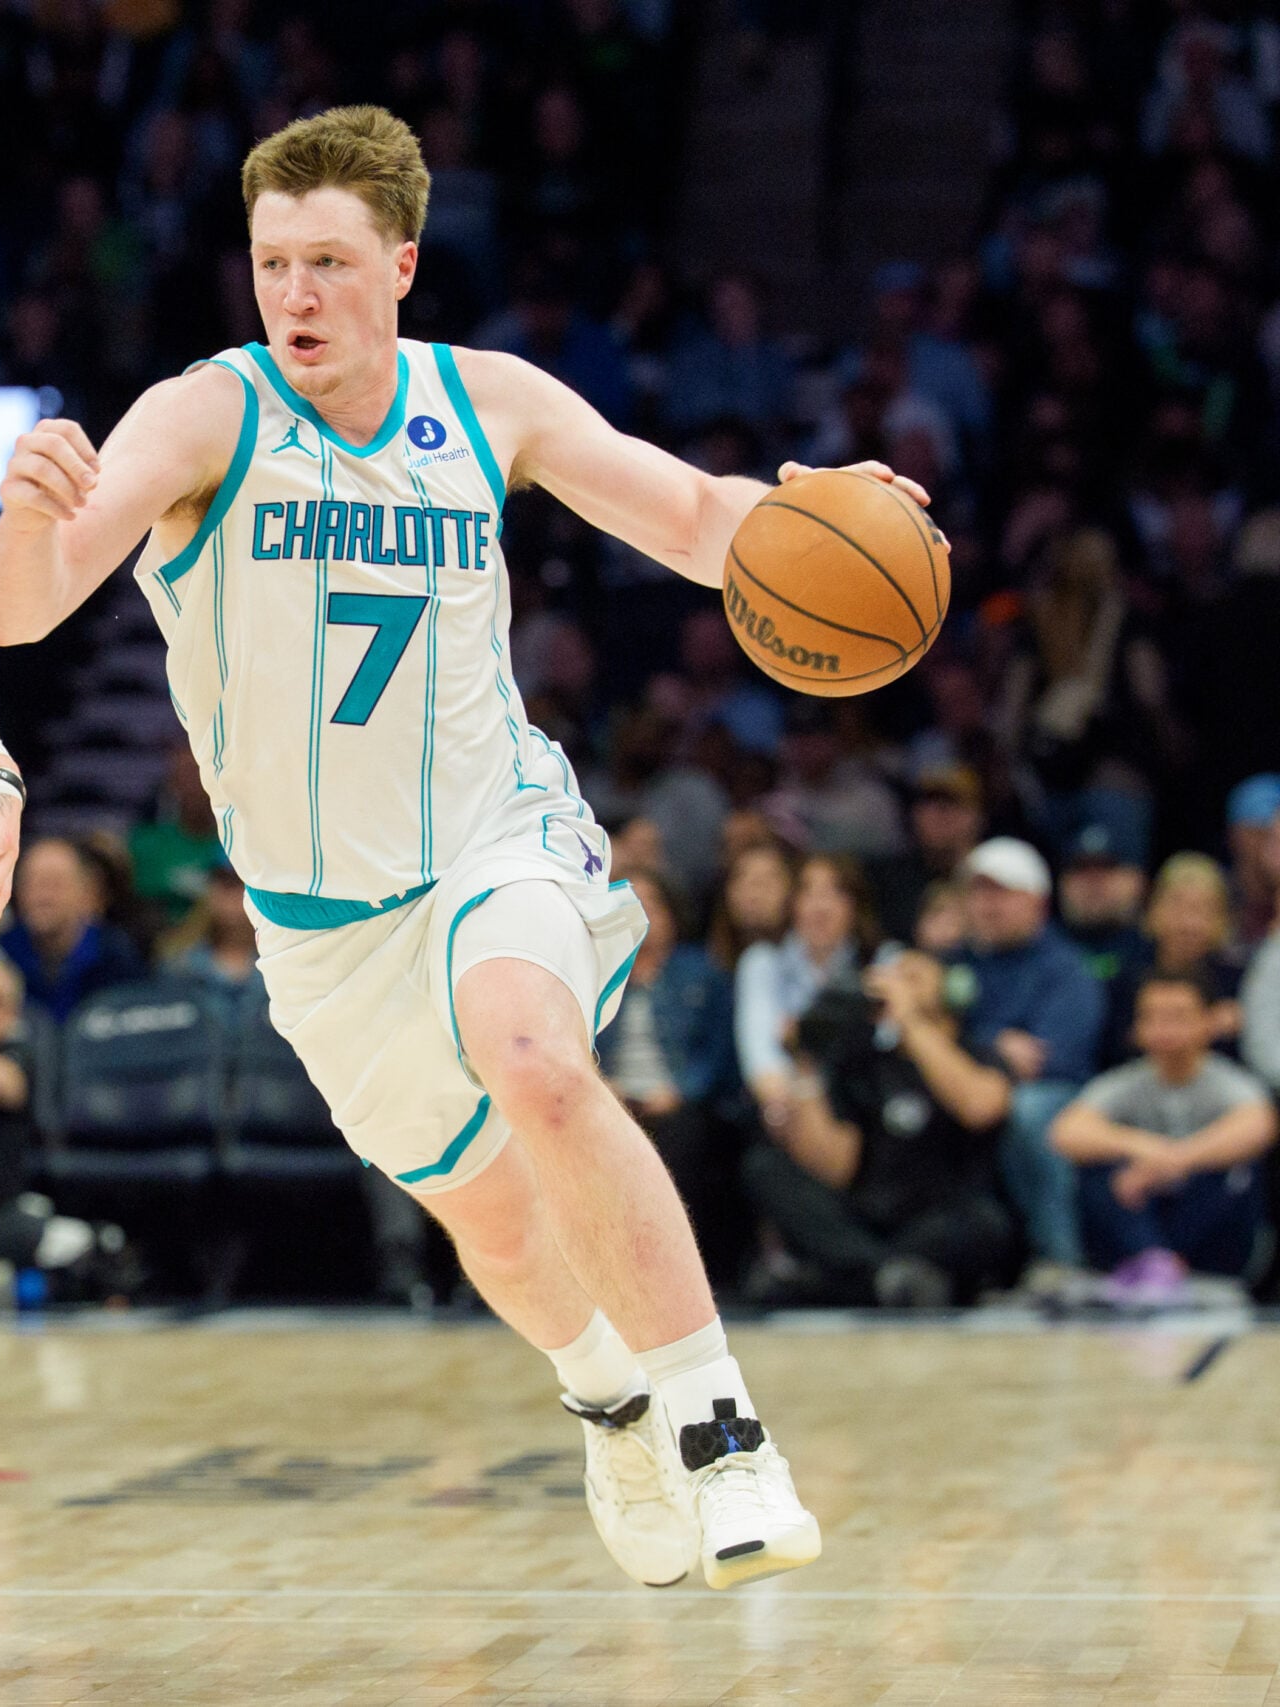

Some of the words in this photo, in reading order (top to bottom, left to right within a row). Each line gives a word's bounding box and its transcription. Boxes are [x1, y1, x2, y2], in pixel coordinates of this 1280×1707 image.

[433, 447, 470, 463] Health
[252, 501, 490, 571] CHARLOTTE
[327, 592, 431, 726] 7
[727, 573, 841, 673] Wilson
